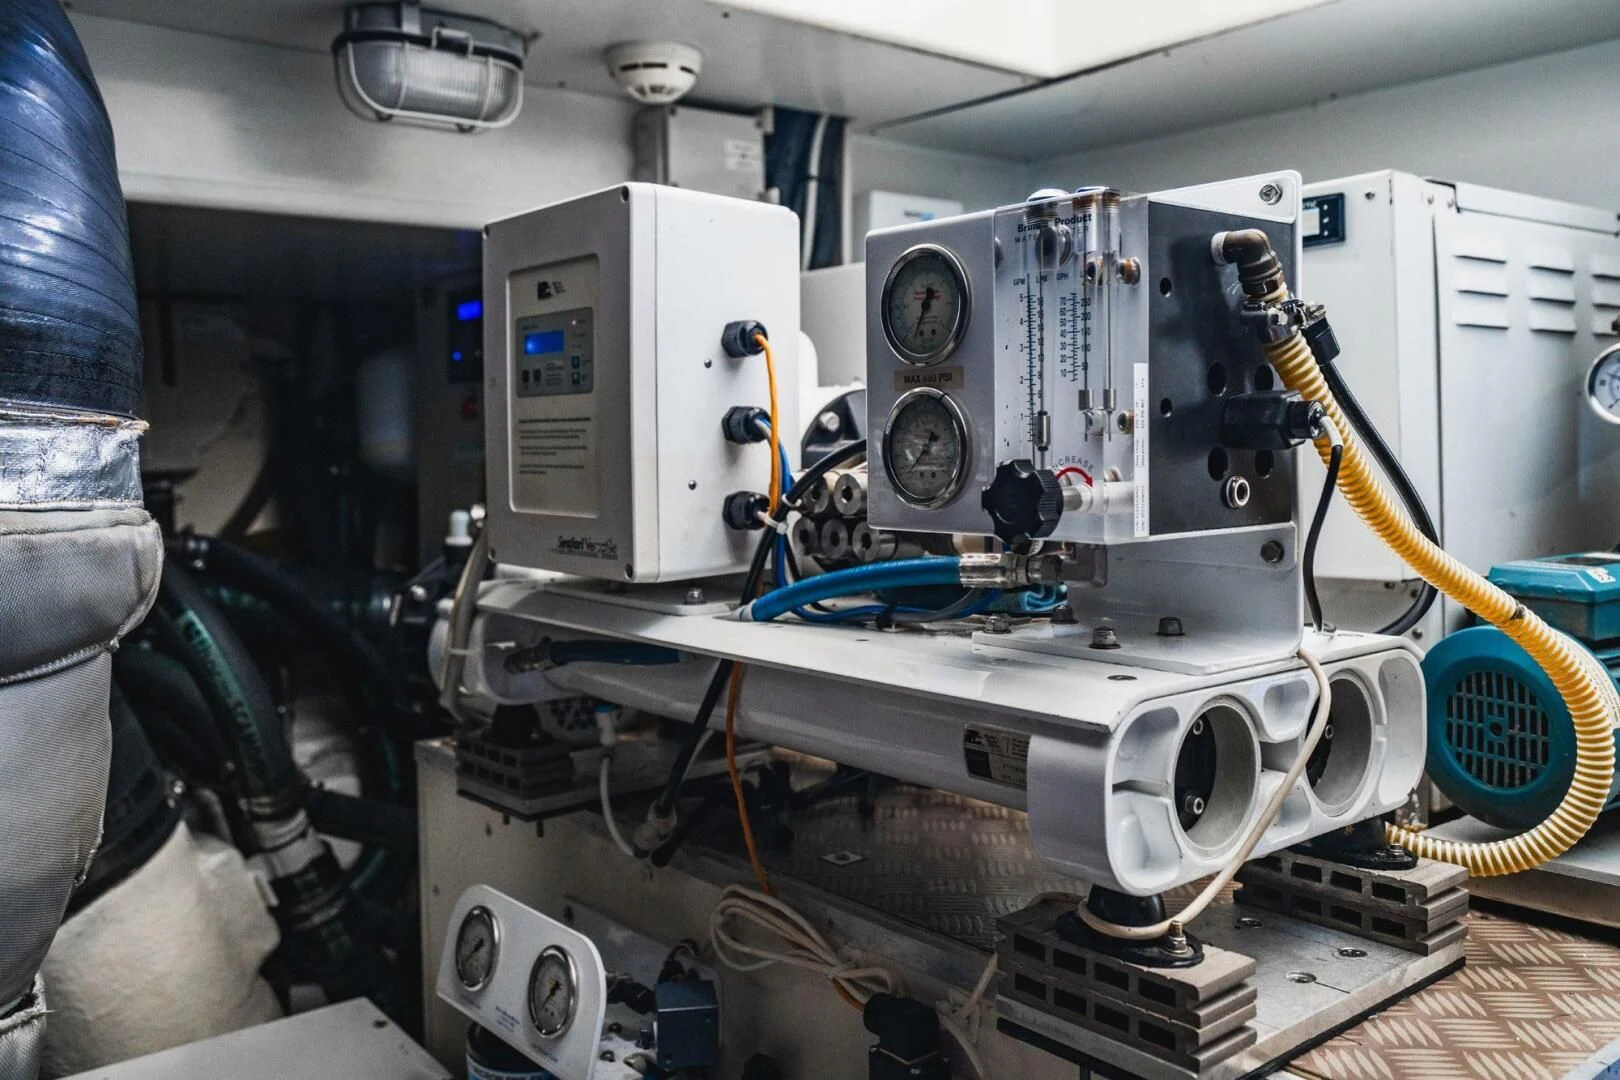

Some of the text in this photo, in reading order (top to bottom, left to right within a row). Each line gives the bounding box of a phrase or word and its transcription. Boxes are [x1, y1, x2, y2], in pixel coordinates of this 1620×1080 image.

[1055, 214, 1092, 226] Product
[1060, 318, 1067, 327] 50
[1060, 329, 1067, 338] 40
[1060, 341, 1067, 351] 30
[1060, 354, 1067, 363] 20
[1060, 368, 1067, 377] 10
[904, 375, 920, 384] MAX
[939, 372, 953, 383] PSI
[1053, 456, 1095, 472] NCREASE
